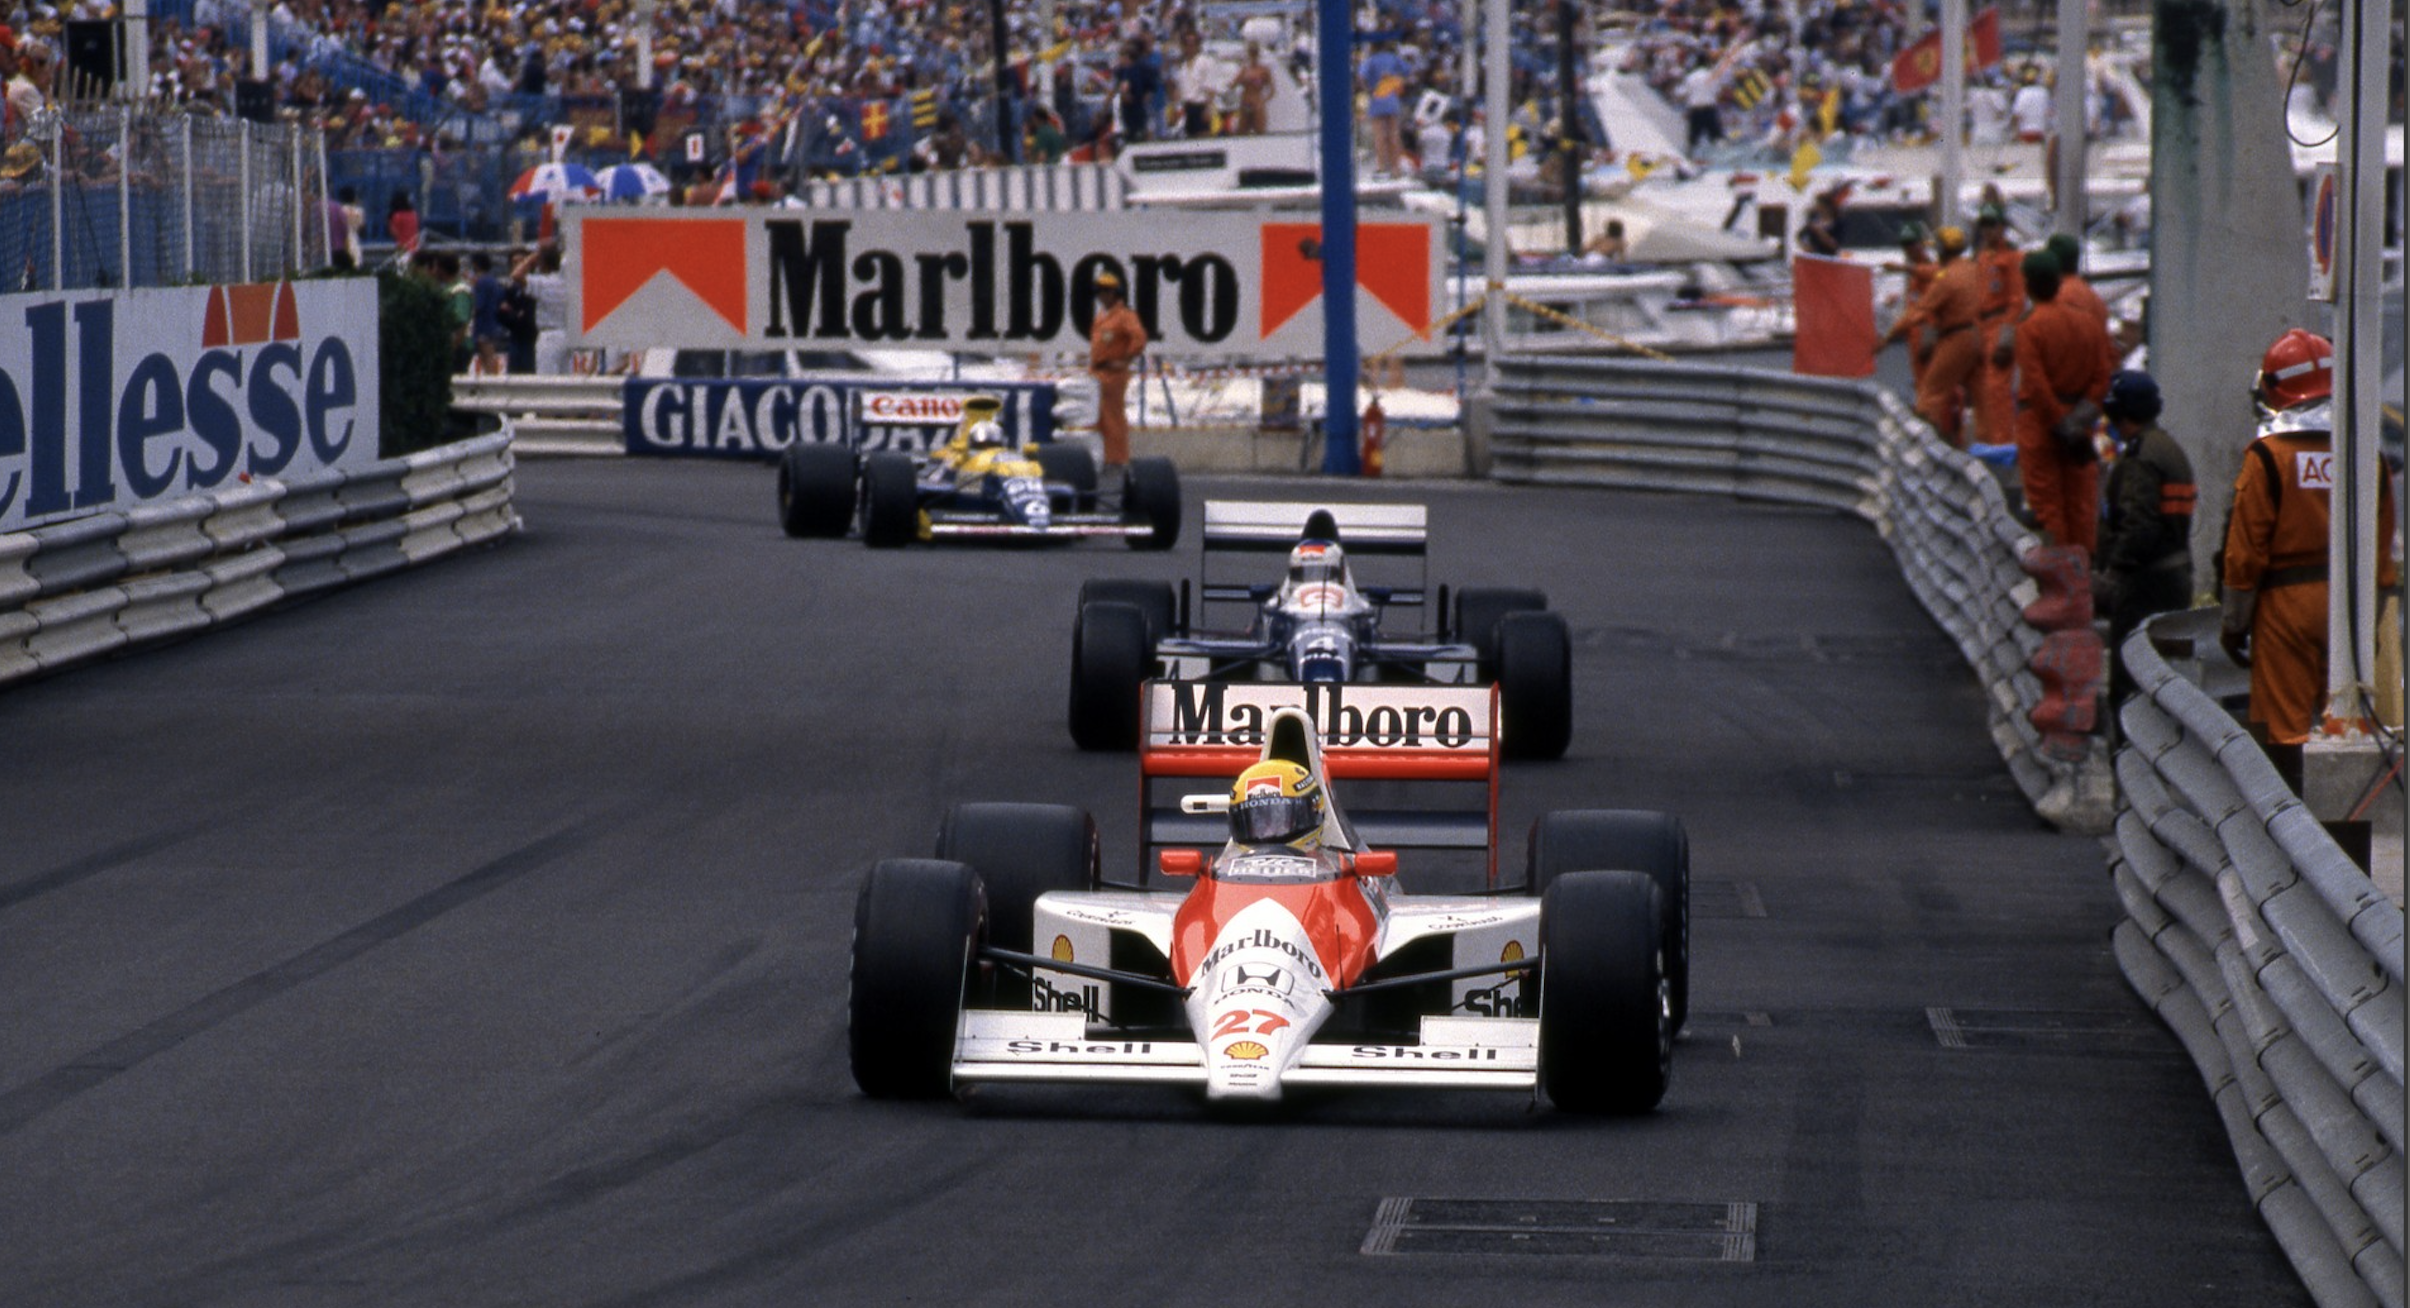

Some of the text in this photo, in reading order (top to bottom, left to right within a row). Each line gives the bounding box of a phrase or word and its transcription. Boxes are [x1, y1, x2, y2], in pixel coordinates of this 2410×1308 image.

[764, 219, 1239, 343] Marlboro
[869, 394, 962, 418] Cano
[1169, 682, 1473, 748] Malboro
[1240, 797, 1291, 810] HONDA
[1201, 929, 1321, 979] Marlboro
[1034, 976, 1099, 1023] Shell
[1213, 987, 1296, 1010] HONDA
[1210, 1008, 1291, 1042] 27
[1007, 1040, 1151, 1055] Shell
[1351, 1046, 1497, 1060] Shell
